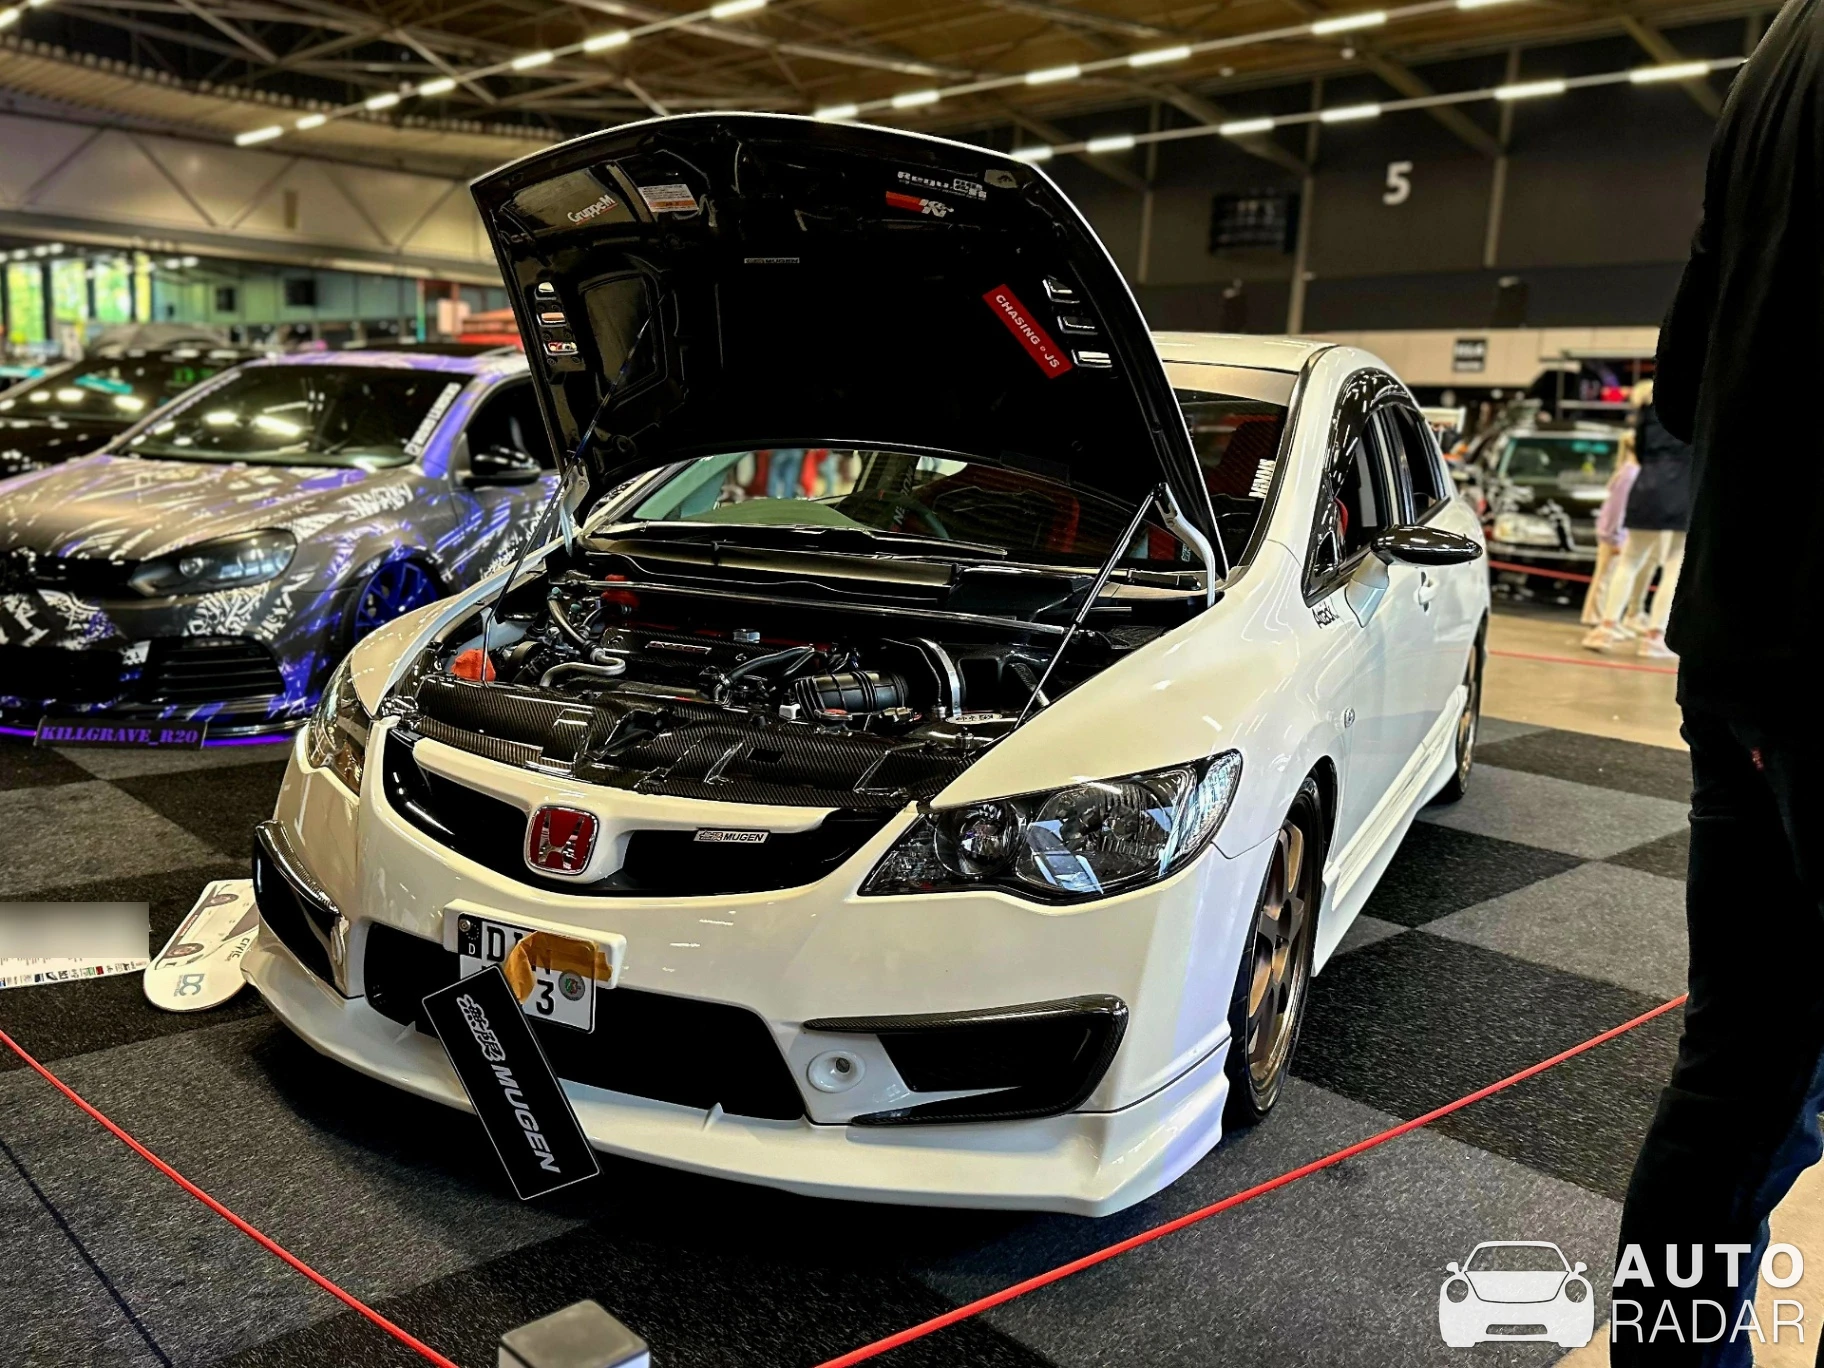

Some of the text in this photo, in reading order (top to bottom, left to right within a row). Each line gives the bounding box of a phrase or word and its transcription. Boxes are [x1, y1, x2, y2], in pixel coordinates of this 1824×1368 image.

[1382, 161, 1413, 205] 5
[567, 194, 616, 222] GruppeM
[996, 294, 1060, 368] CHASING JS
[40, 726, 199, 745] KILLGRAVE_R20
[723, 833, 765, 842] MUGEN
[468, 943, 476, 955] D
[179, 973, 205, 996] DC
[491, 1063, 561, 1174] MUGEN
